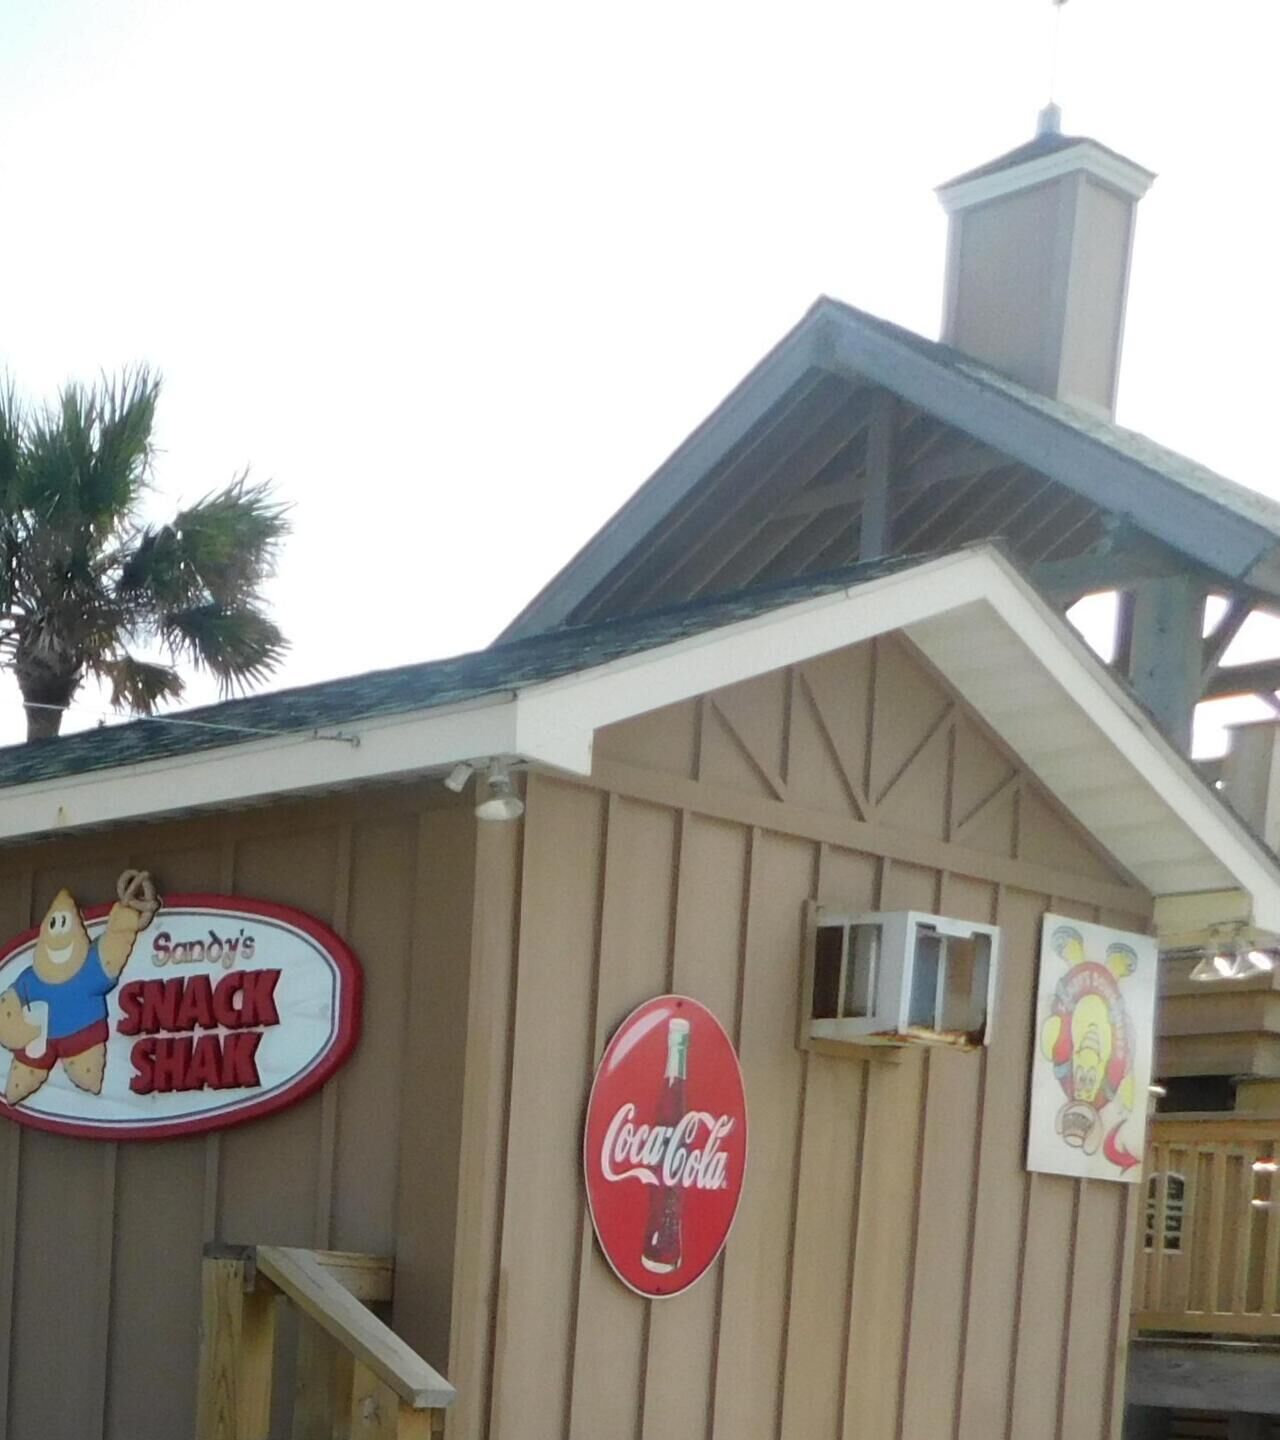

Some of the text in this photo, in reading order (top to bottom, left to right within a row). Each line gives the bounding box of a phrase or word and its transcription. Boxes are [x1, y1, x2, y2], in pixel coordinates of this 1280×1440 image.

[152, 929, 255, 968] Sandy's
[117, 969, 282, 1036] SNACK
[129, 1033, 263, 1094] SHAK
[601, 1103, 734, 1190] Coca-Cola
